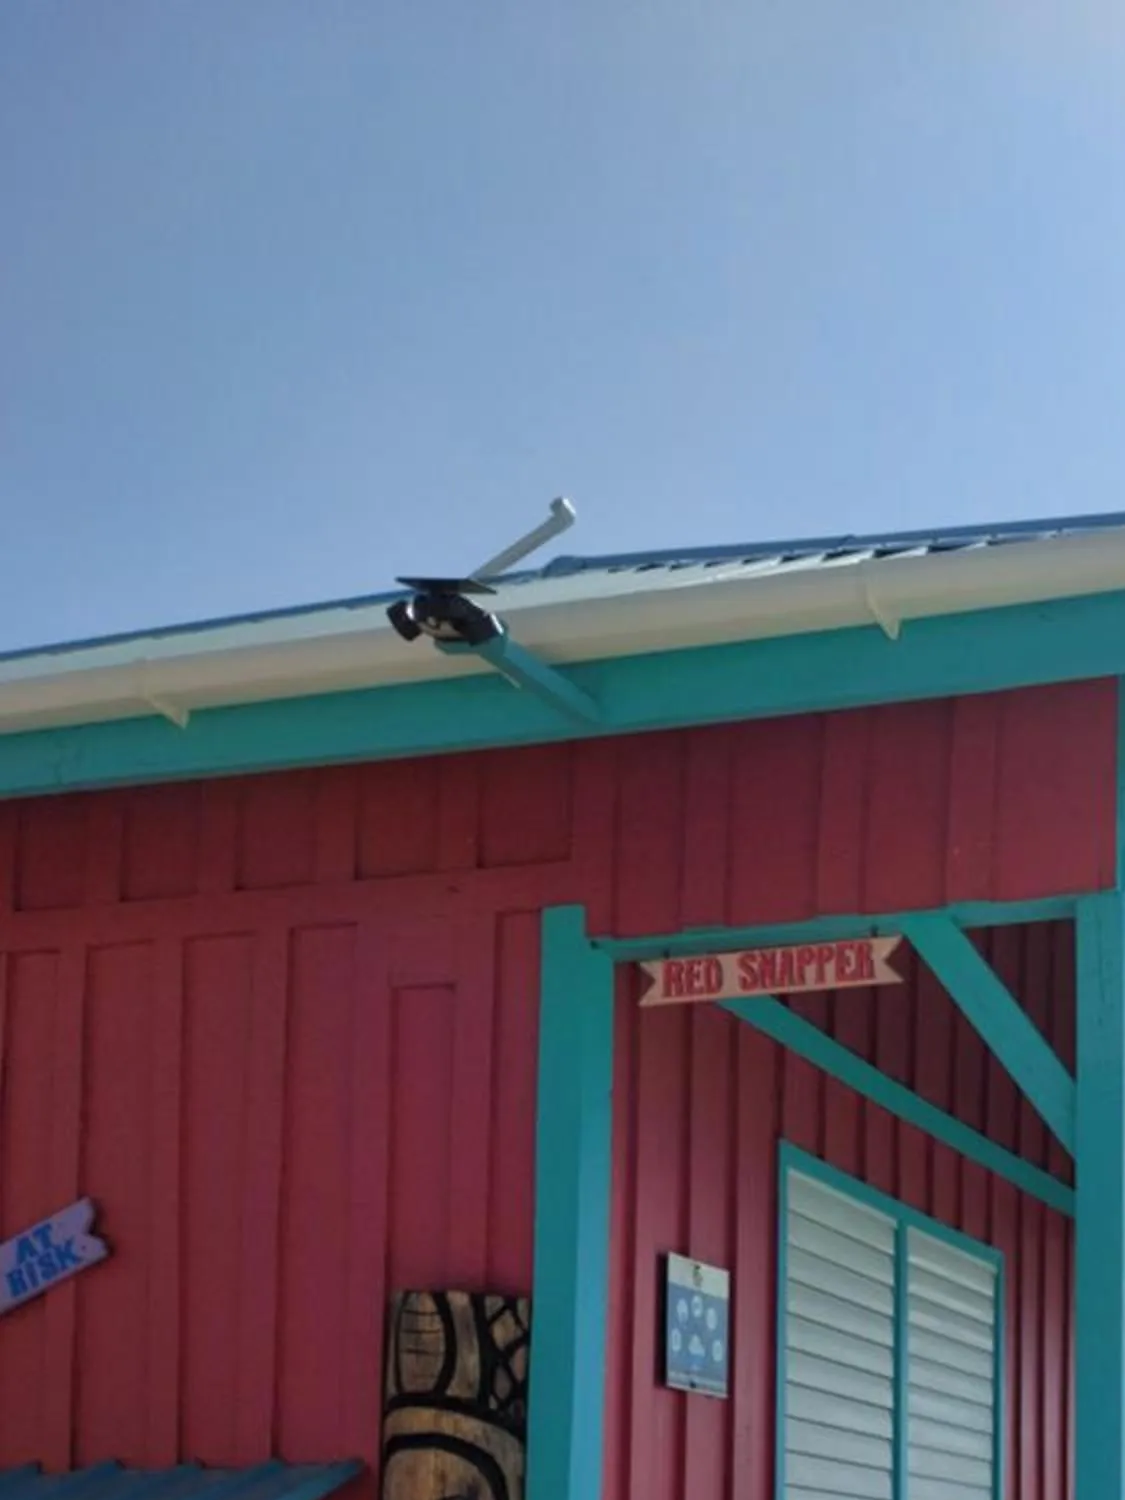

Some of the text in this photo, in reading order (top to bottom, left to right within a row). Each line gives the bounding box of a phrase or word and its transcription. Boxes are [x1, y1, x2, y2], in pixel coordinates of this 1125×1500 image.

[662, 941, 876, 998] RED SNAPPER
[6, 1236, 81, 1298] RISK
[17, 1222, 53, 1266] AT
